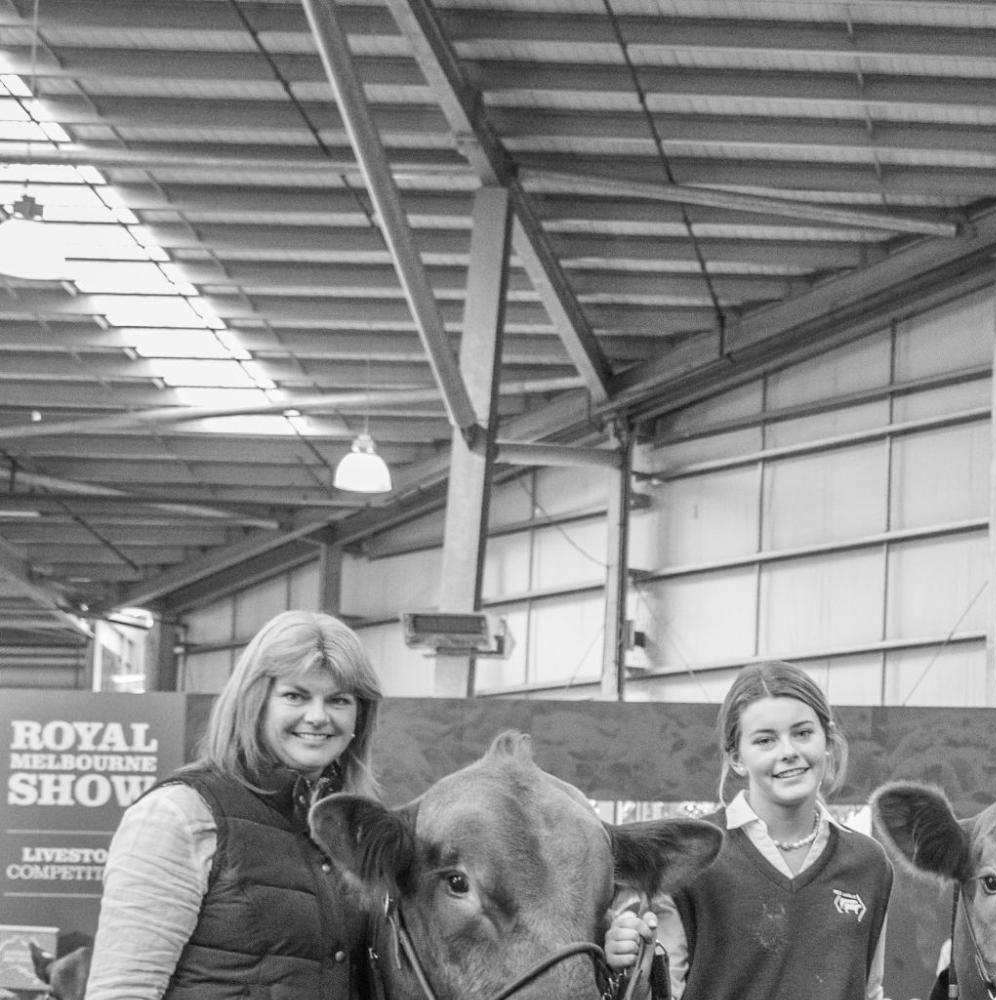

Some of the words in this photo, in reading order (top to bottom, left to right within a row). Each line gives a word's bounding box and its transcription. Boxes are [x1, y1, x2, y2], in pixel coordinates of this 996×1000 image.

[10, 720, 158, 752] ROYAL
[10, 753, 158, 772] MELBOURNE
[7, 773, 157, 807] SHOW
[22, 847, 108, 864] LIVESTO
[6, 864, 105, 880] COMPETIT
